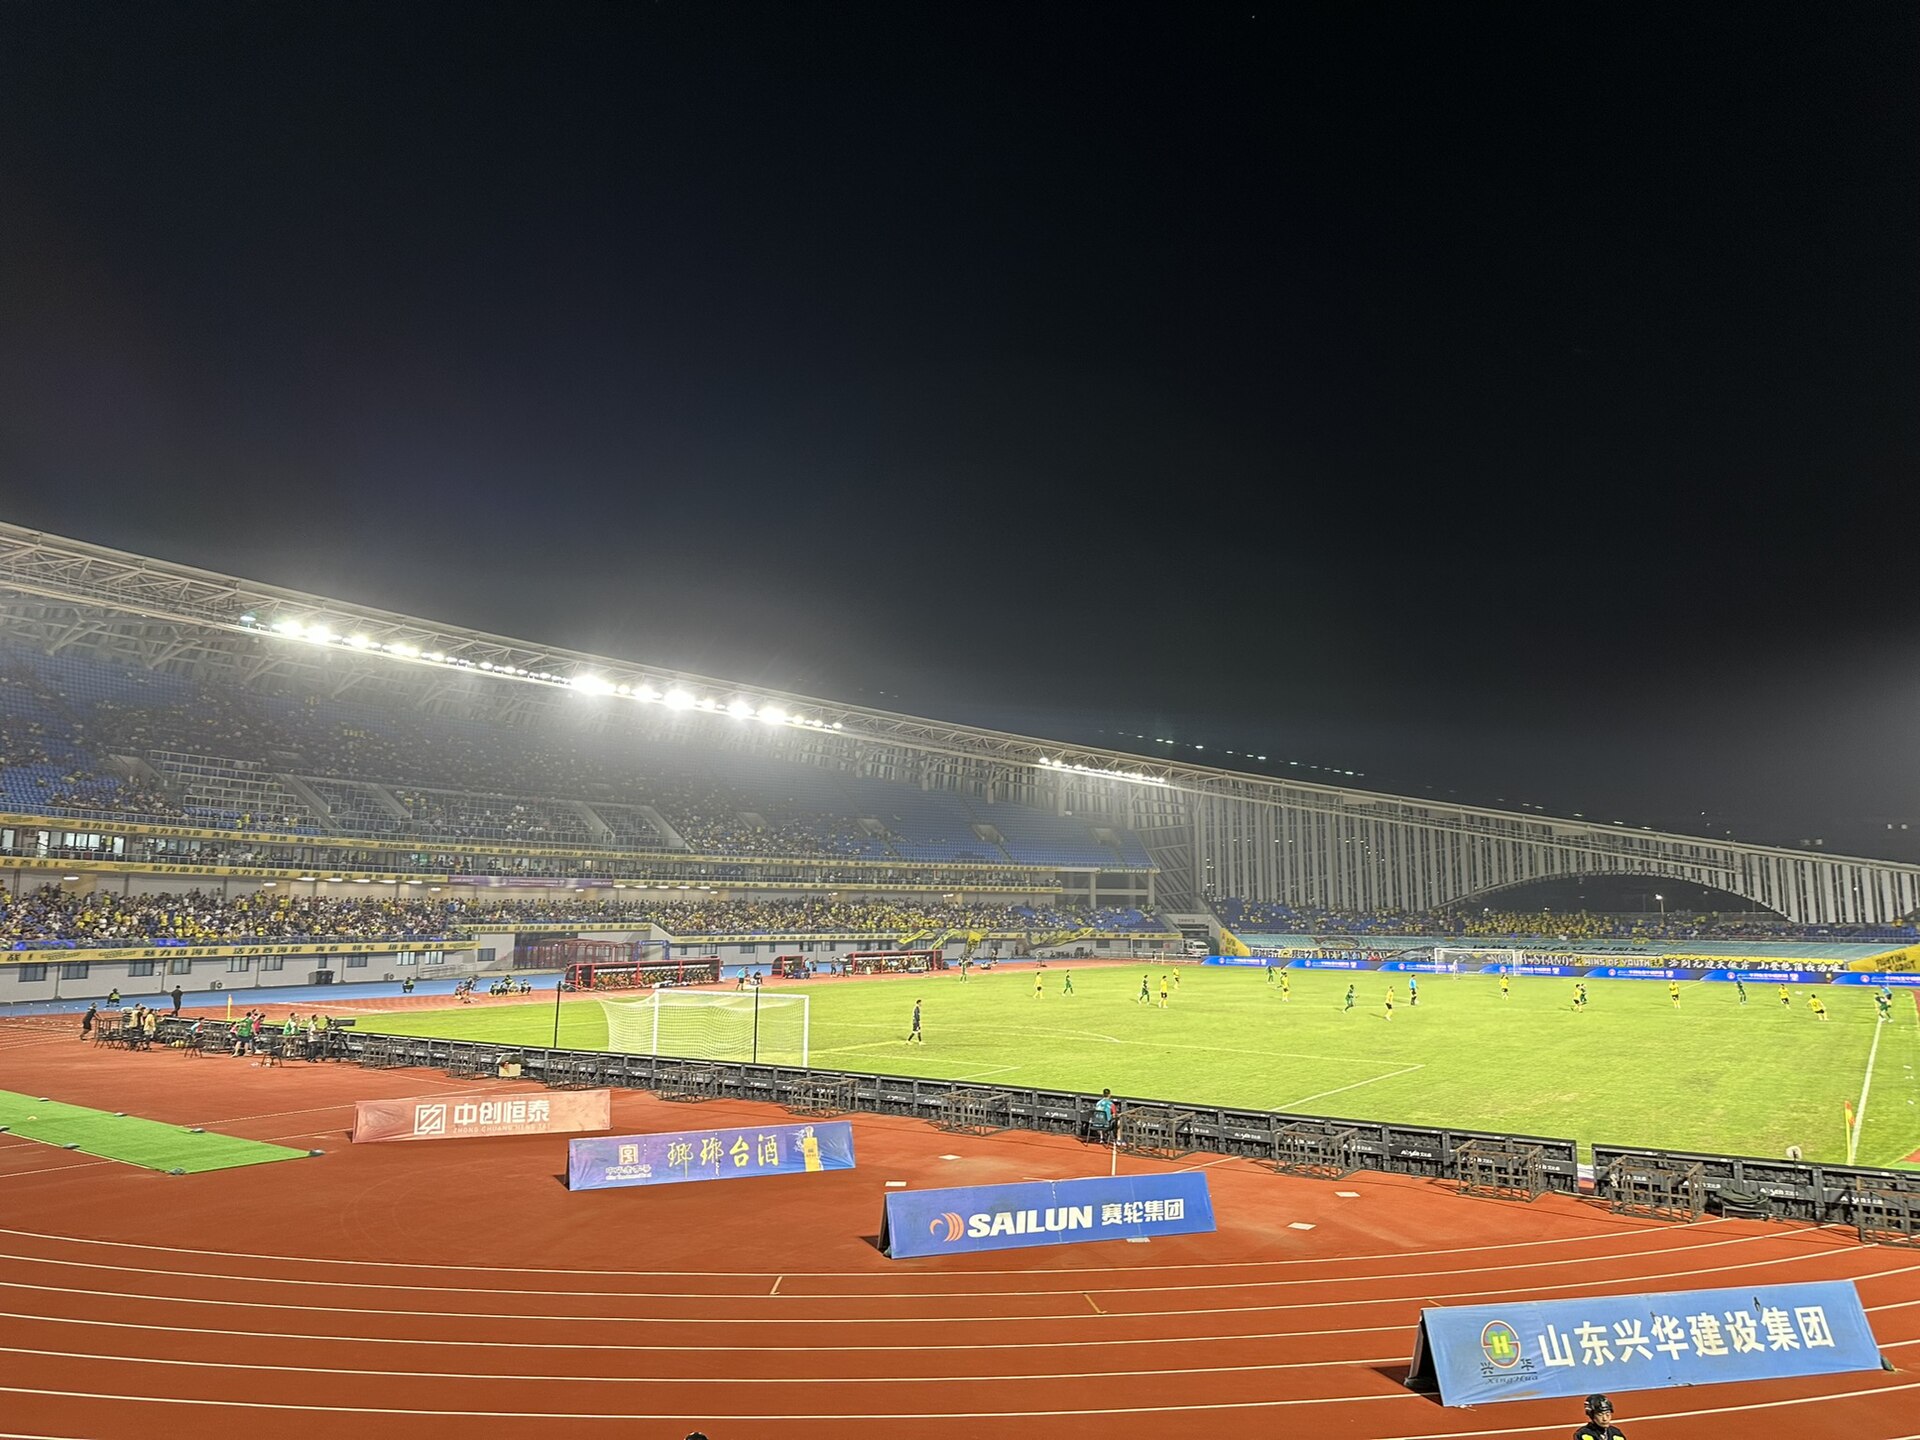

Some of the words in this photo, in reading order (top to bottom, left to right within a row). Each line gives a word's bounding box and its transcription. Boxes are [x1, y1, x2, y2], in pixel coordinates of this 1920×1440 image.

[1490, 953, 1527, 965] NORH
[1622, 958, 1650, 968] YOUTH
[452, 1099, 550, 1126] 中创恒泰
[452, 1126, 479, 1134] ZHONG
[481, 1124, 513, 1133] CHUANG
[967, 1205, 1093, 1238] SAILUN
[1101, 1198, 1184, 1226] 赛轮集团
[1537, 1305, 1836, 1367] 山东兴华建设集团
[1485, 1374, 1539, 1385] XingHua
